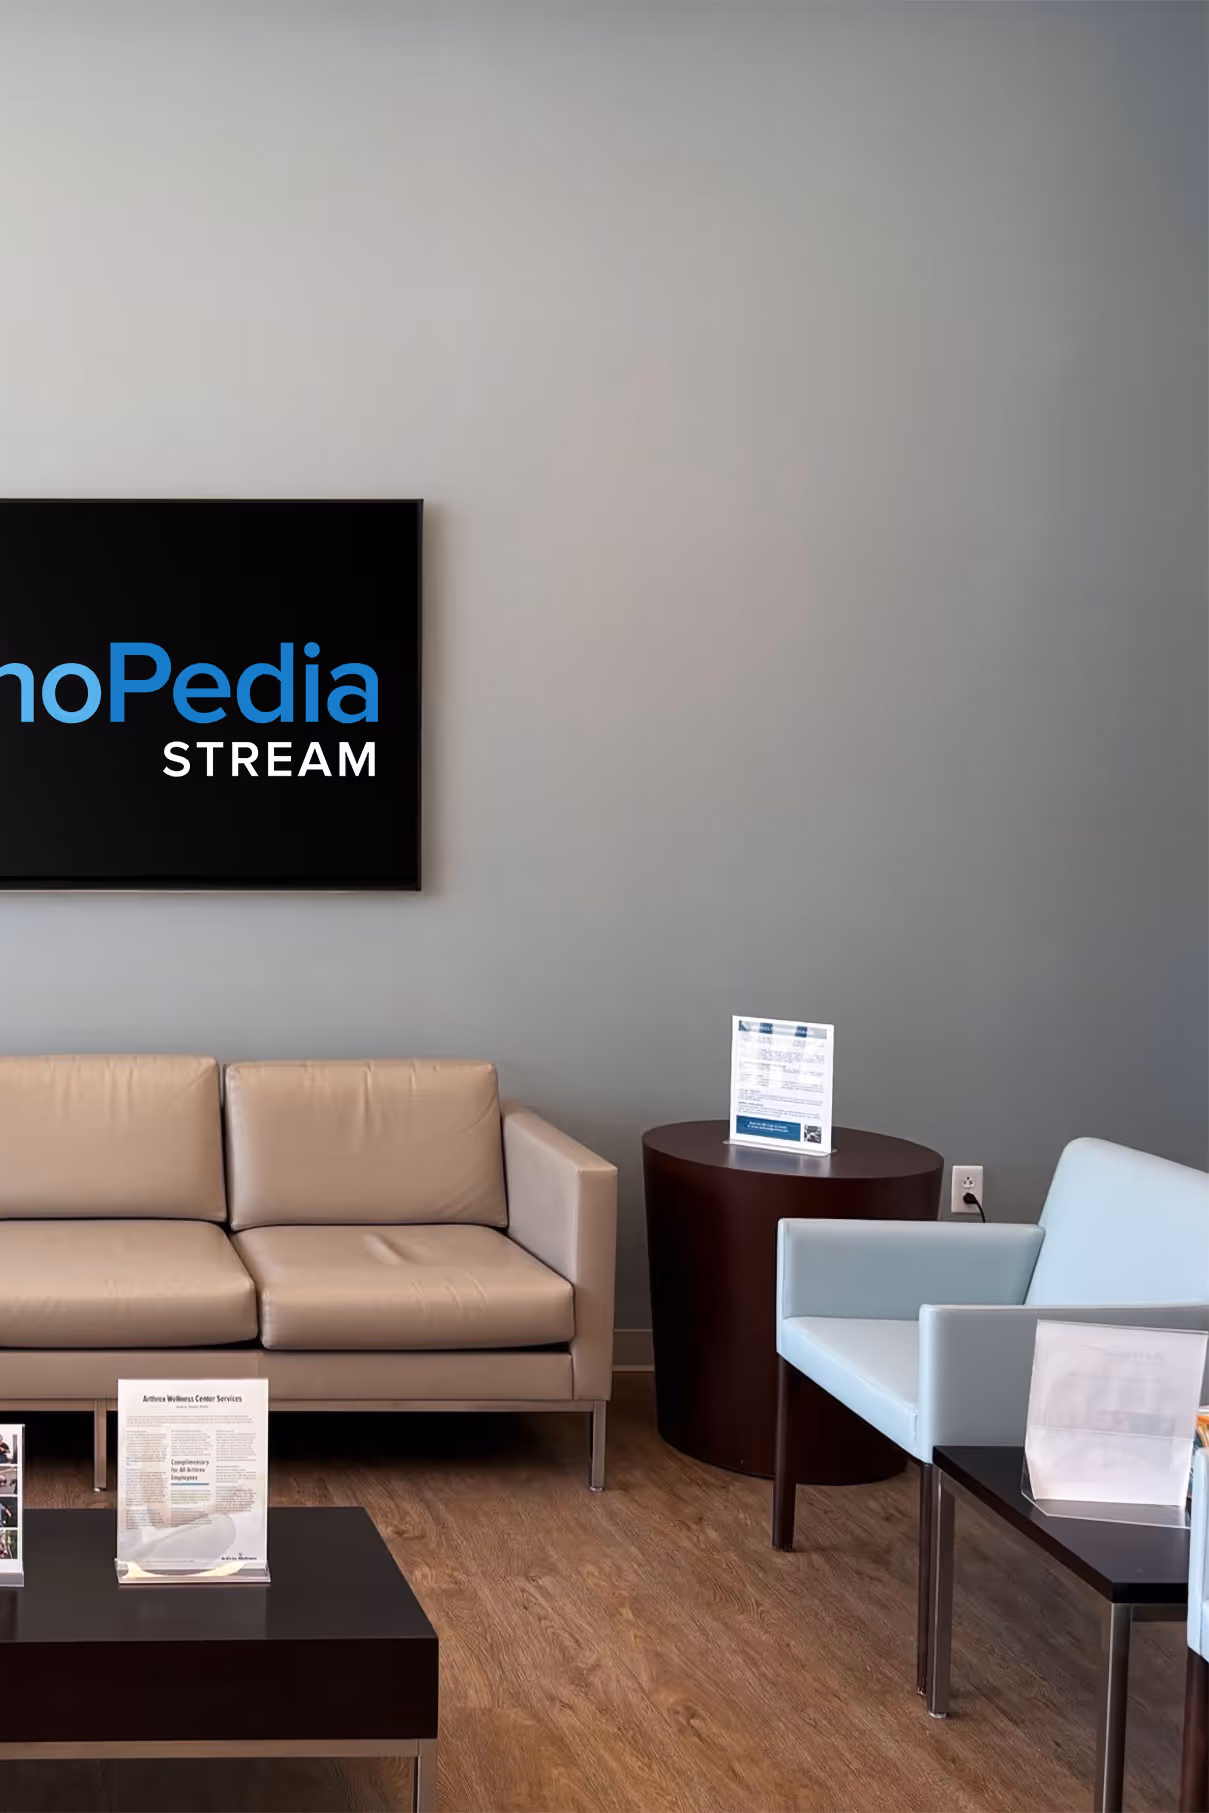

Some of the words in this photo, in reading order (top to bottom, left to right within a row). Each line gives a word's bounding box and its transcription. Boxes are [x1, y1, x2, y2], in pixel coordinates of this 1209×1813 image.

[163, 740, 377, 778] STREAM
[142, 1395, 166, 1403] Arthrex
[167, 1395, 194, 1403] Wellness
[195, 1395, 215, 1403] Center
[216, 1395, 243, 1403] Services
